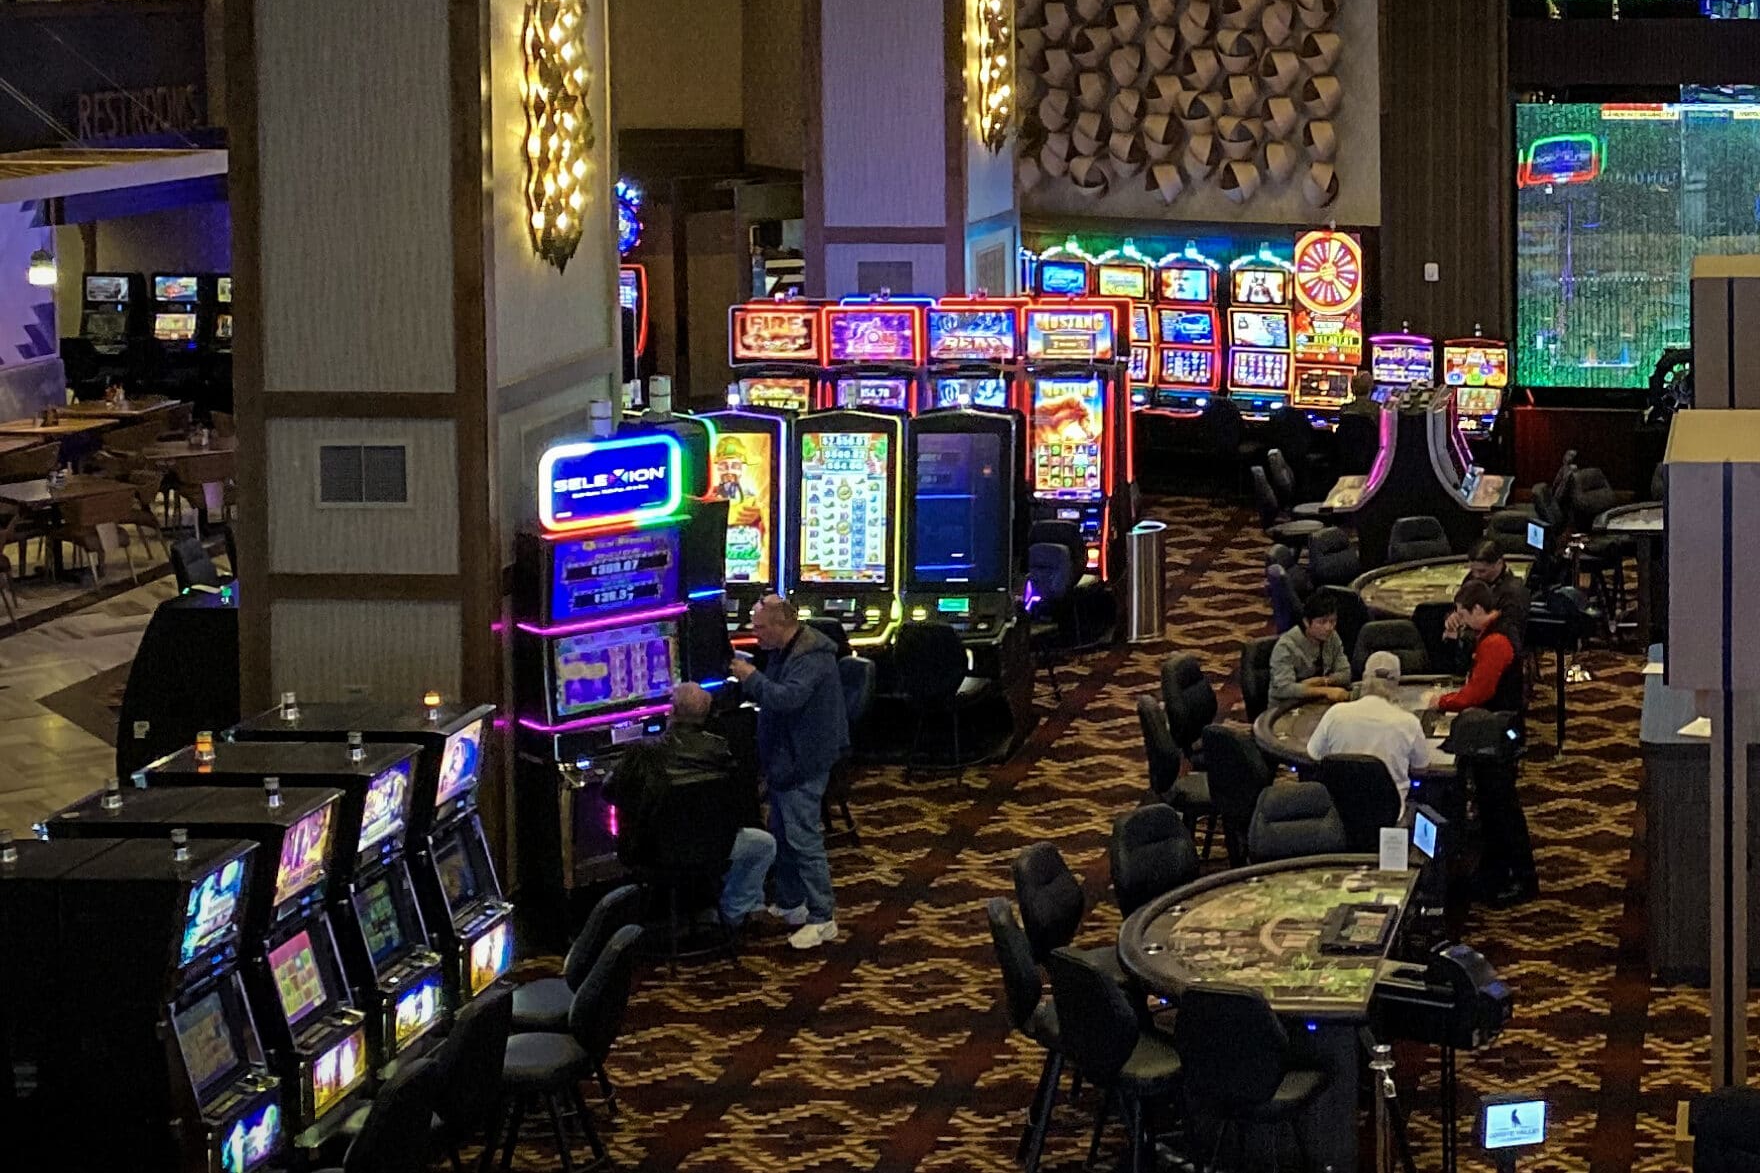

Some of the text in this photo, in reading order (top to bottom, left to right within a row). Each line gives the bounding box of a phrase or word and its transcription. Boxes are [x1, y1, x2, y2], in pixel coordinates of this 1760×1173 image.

[78, 84, 199, 141] RESTROOMS
[748, 315, 803, 331] FIRE
[1035, 314, 1105, 331] MUSTANG
